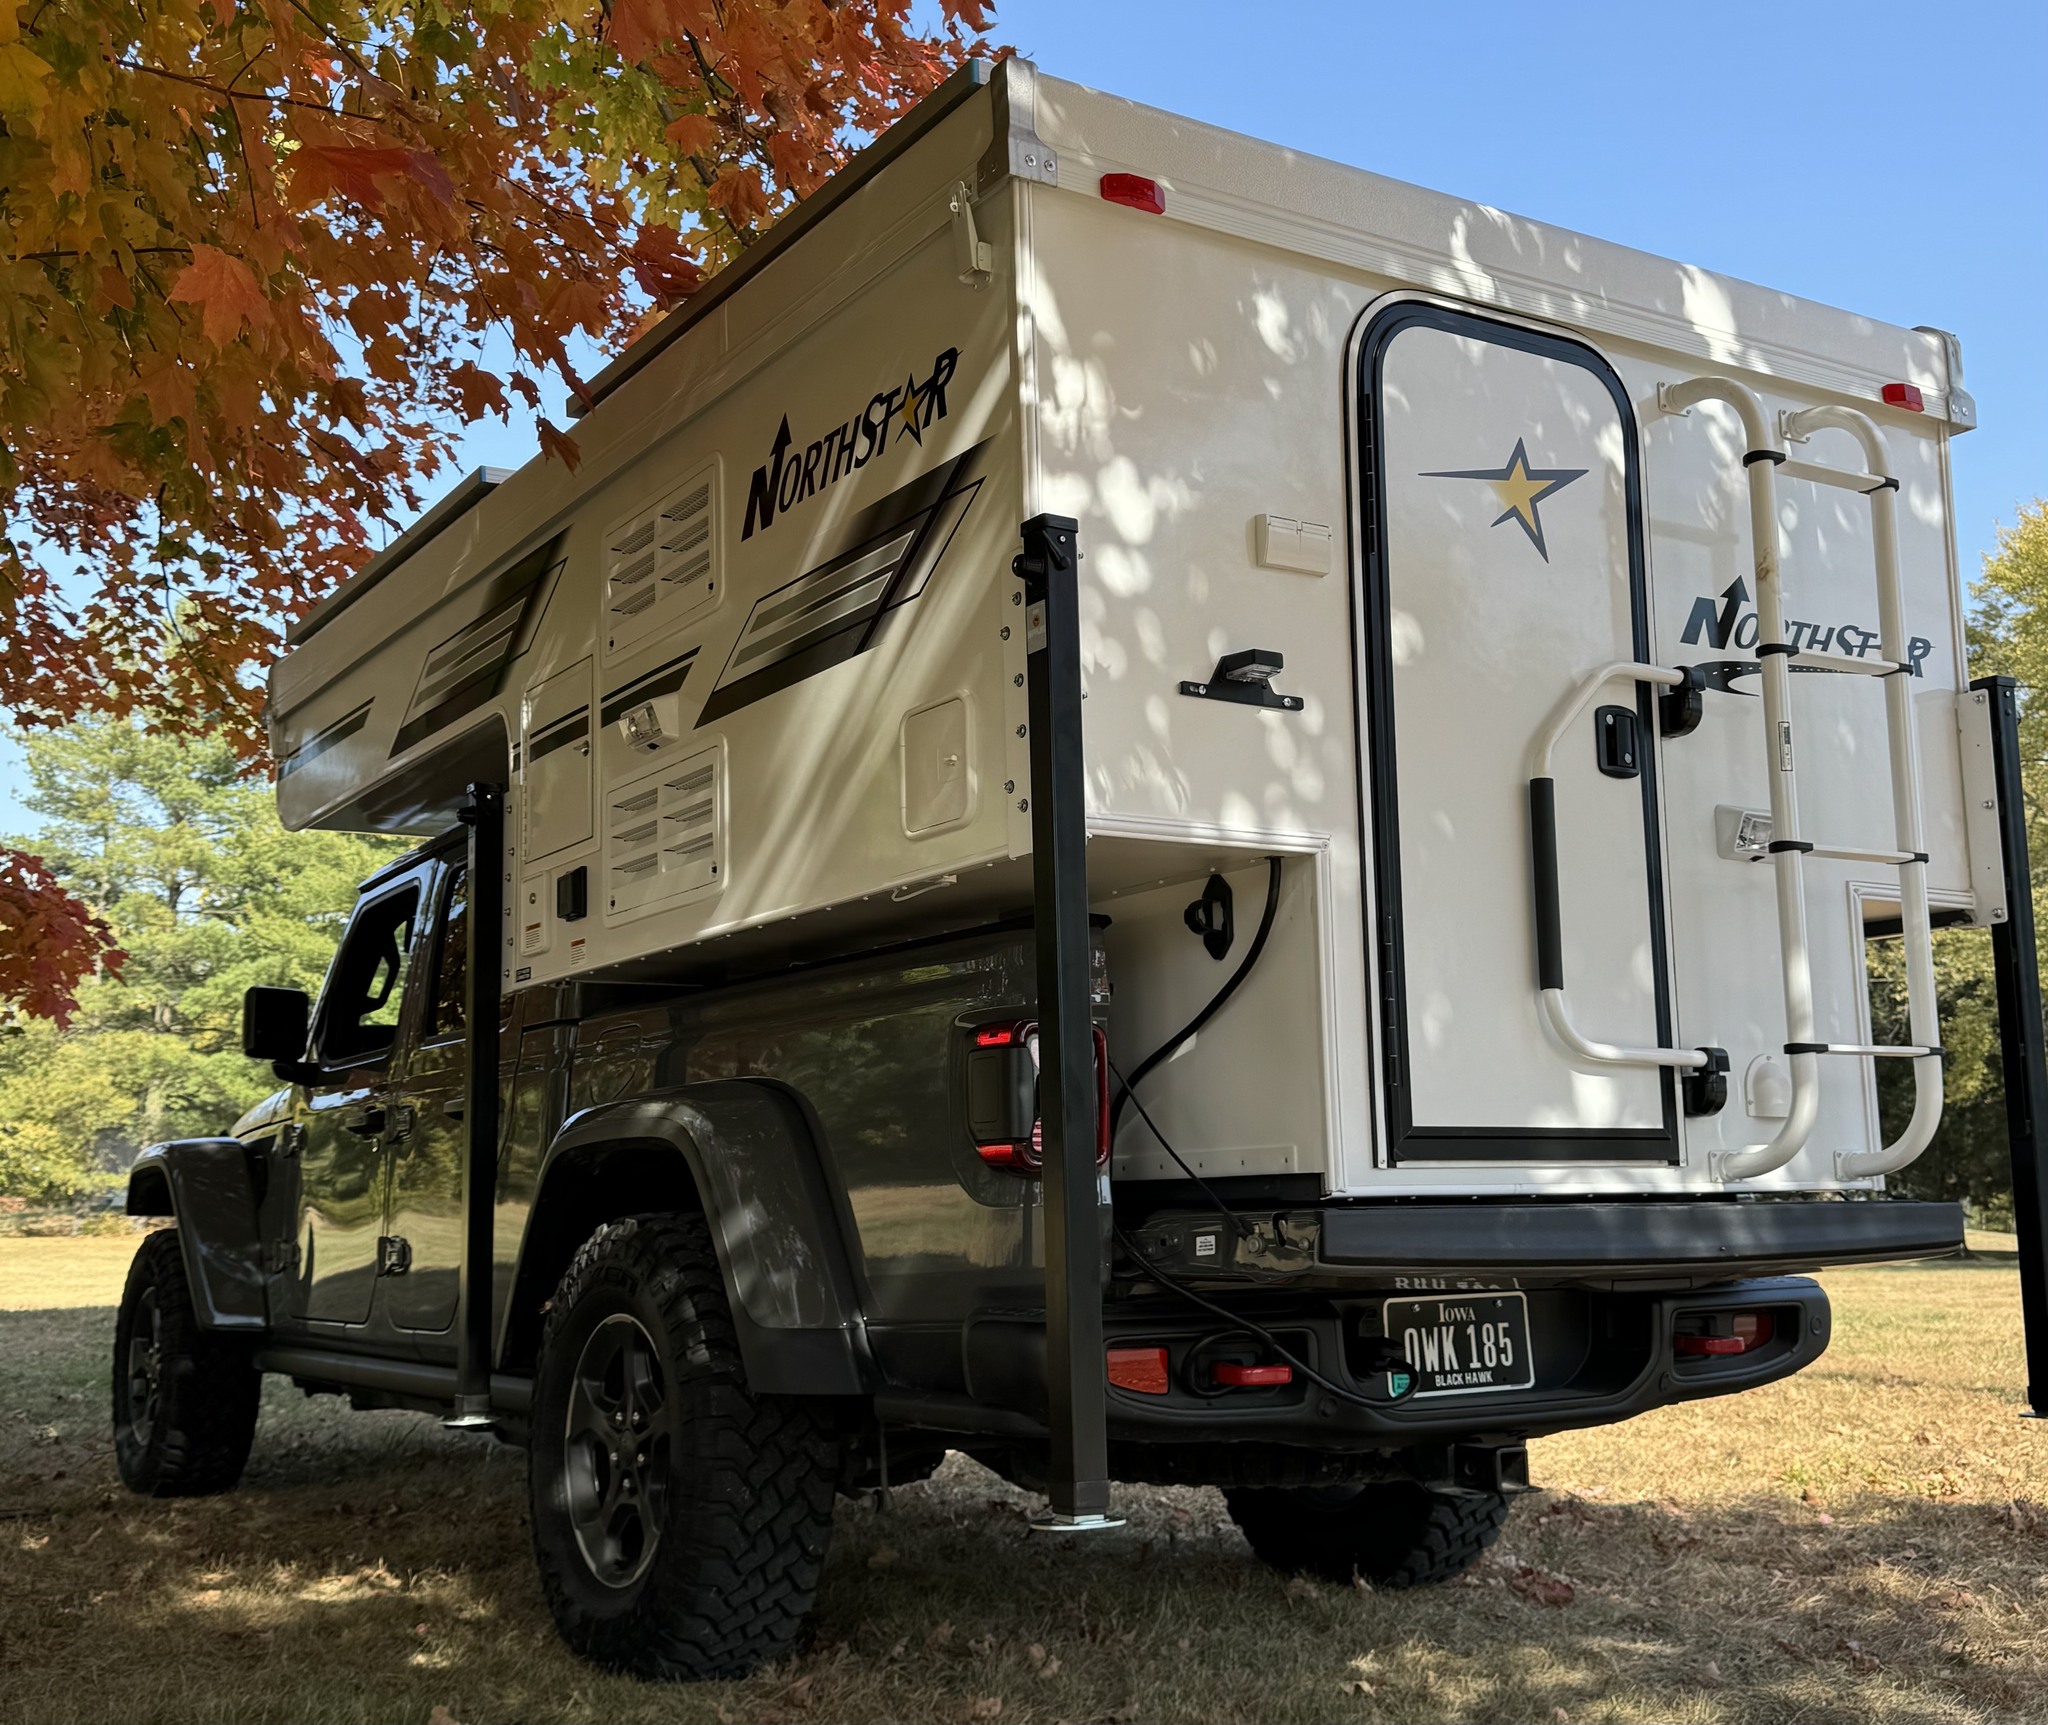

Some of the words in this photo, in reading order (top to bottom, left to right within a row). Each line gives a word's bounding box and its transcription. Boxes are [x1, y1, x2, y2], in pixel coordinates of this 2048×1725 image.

[1680, 575, 1935, 678] NOTHSTR
[1466, 1322, 1513, 1369] 185
[1435, 1373, 1464, 1387] BLACK
[1465, 1371, 1494, 1384] HAWK
